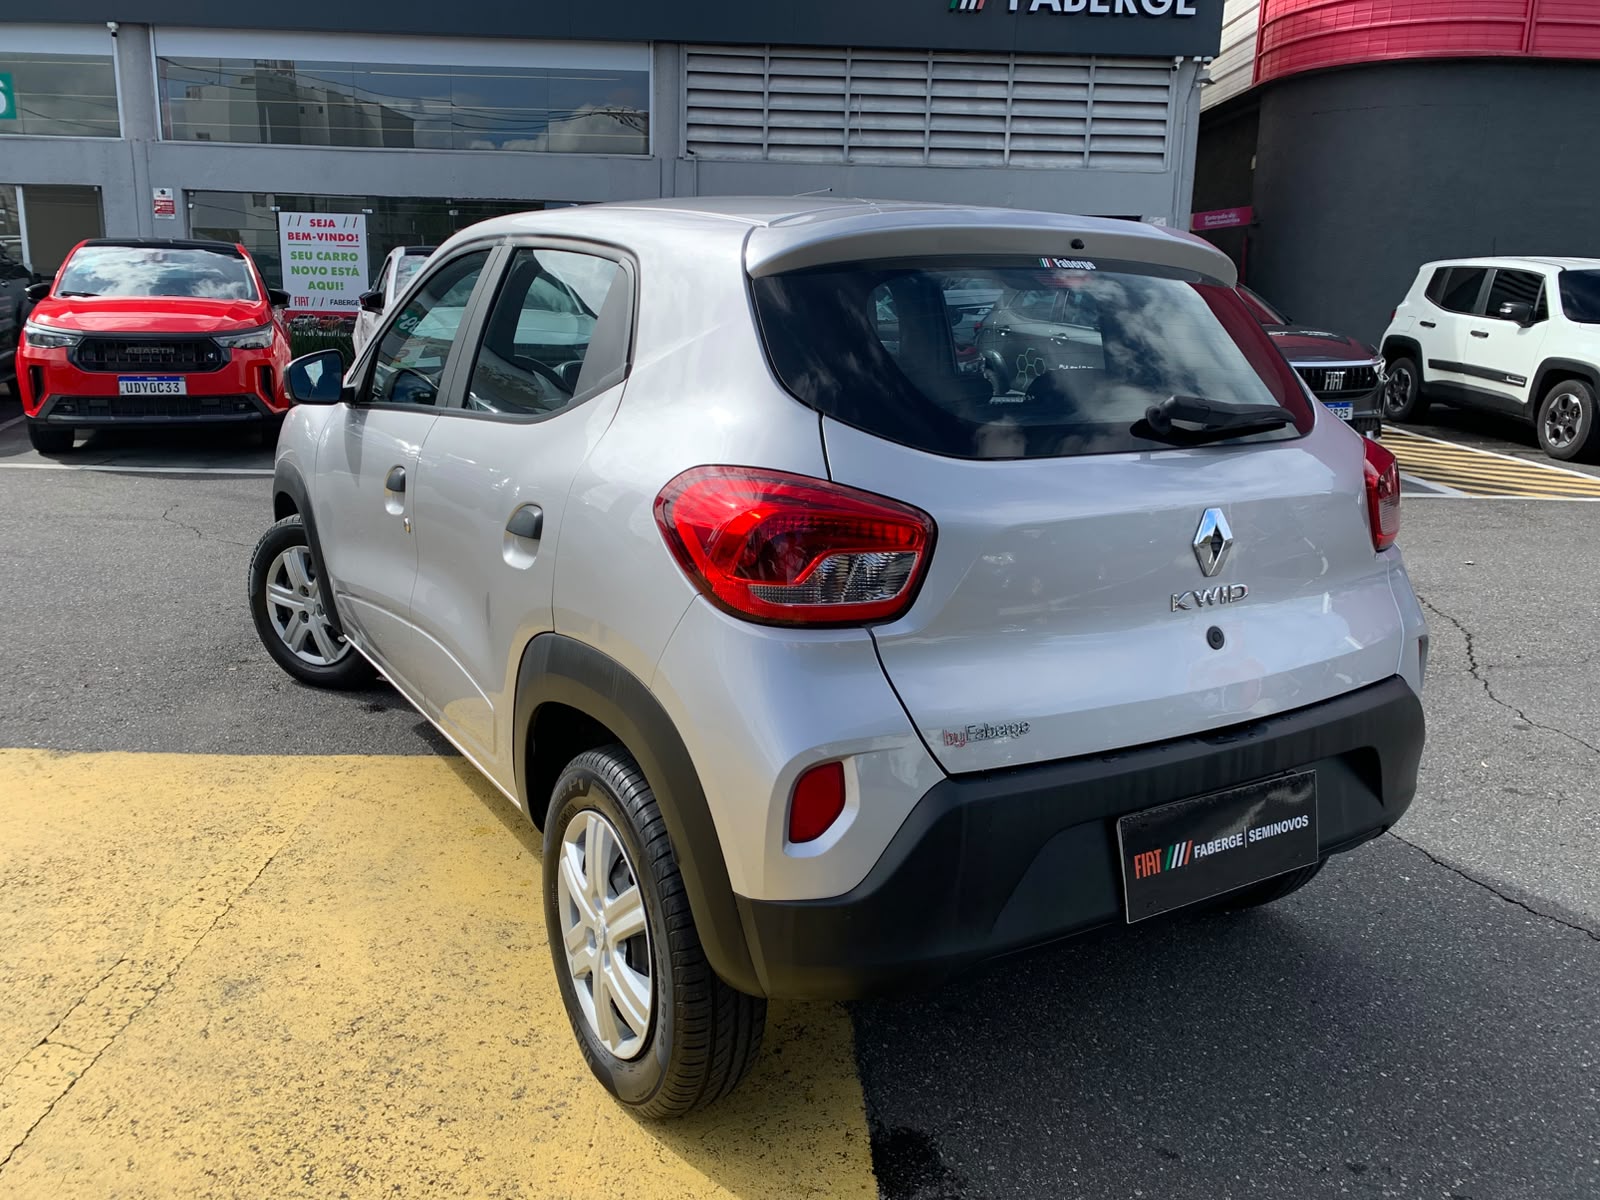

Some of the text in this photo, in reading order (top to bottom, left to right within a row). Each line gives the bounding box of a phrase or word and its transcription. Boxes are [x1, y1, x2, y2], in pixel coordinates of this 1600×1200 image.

[309, 218, 336, 228] SEJA
[287, 231, 359, 242] BEM-VINDO!
[290, 251, 359, 262] SEU CARRO
[291, 264, 360, 276] NOVO ESTÁ
[1052, 258, 1096, 271] Faberge
[308, 281, 344, 291] AQUI!
[294, 296, 360, 307] FIAT FABERGE
[1324, 371, 1346, 390] FIAT
[1170, 583, 1249, 612] KWID
[1133, 815, 1310, 880] FIAT FABERGE SEMINOVOS
